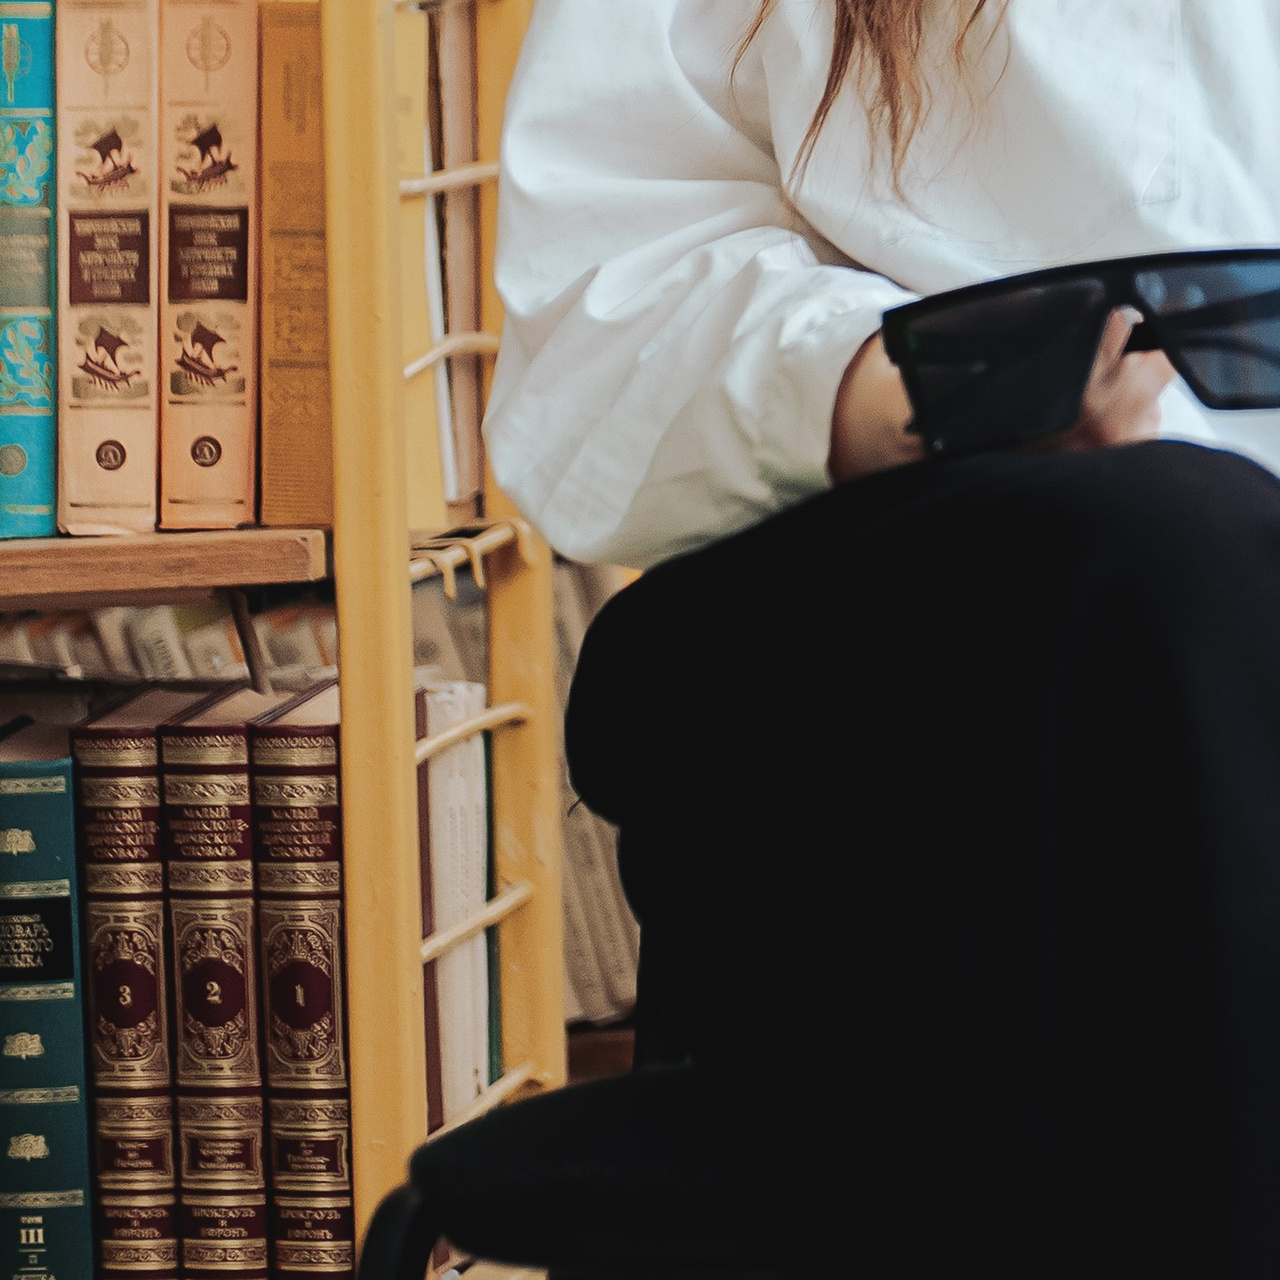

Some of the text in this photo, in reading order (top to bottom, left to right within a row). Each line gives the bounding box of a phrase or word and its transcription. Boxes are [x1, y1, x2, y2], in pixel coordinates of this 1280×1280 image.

[0, 938, 54, 952] ССКОГО
[119, 985, 132, 1006] 3
[206, 981, 223, 1005] 2
[295, 984, 305, 1007] 1
[20, 1229, 44, 1244] III
